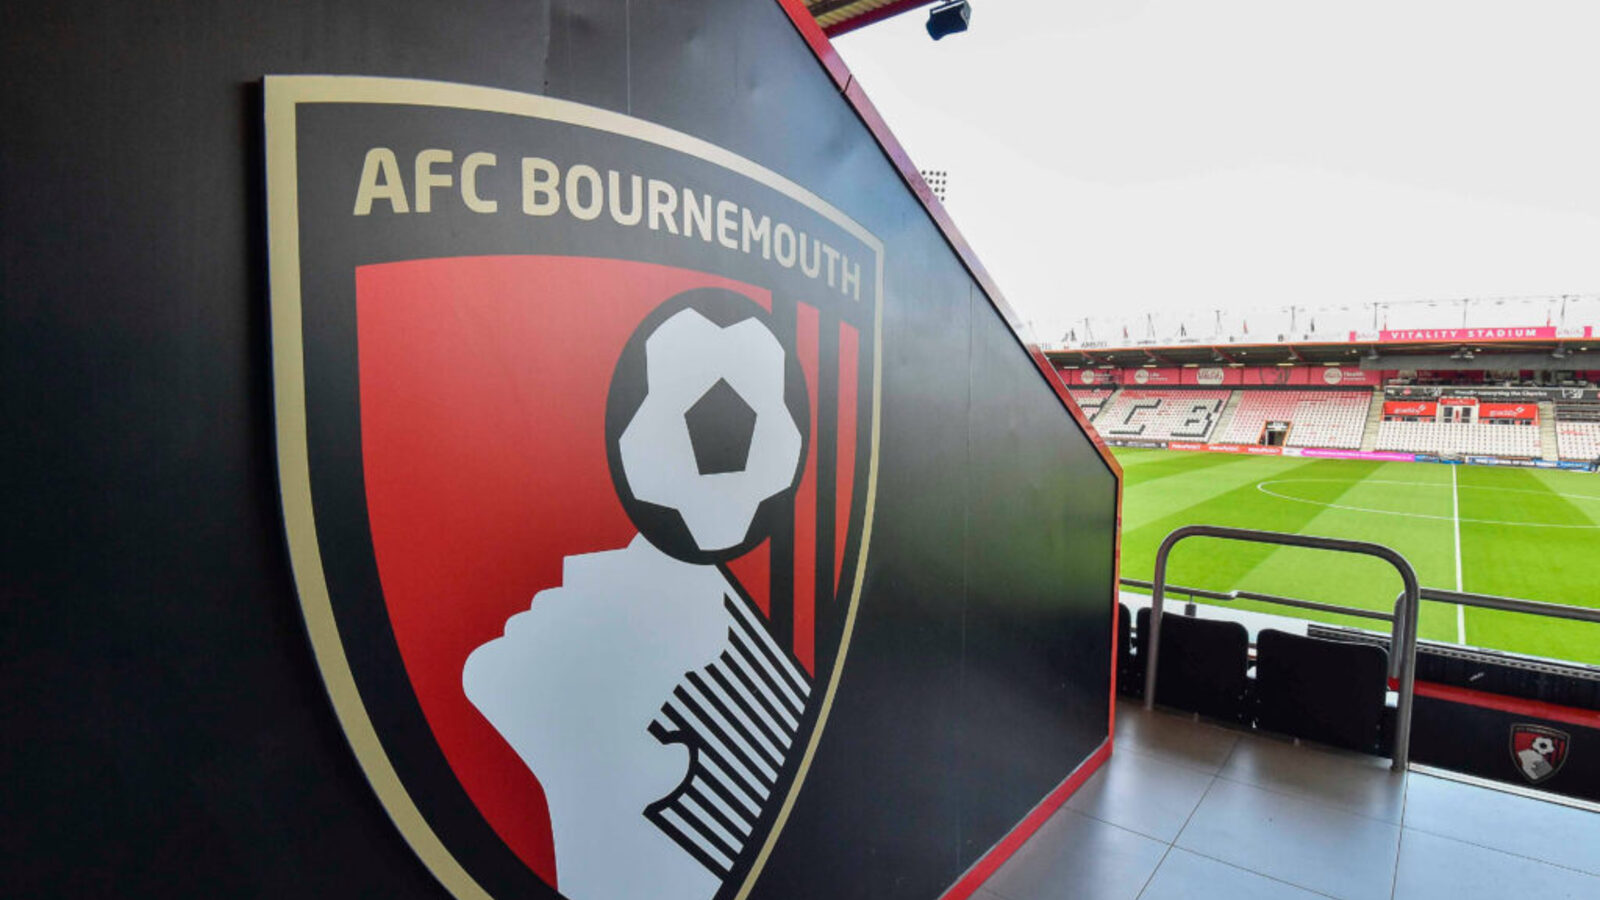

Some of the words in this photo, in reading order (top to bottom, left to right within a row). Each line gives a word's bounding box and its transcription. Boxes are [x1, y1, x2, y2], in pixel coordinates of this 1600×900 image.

[352, 147, 498, 216] AFC
[521, 156, 861, 301] BOURNEMOUTH
[1391, 330, 1458, 339] VITALITY
[1468, 328, 1537, 338] STADIUM
